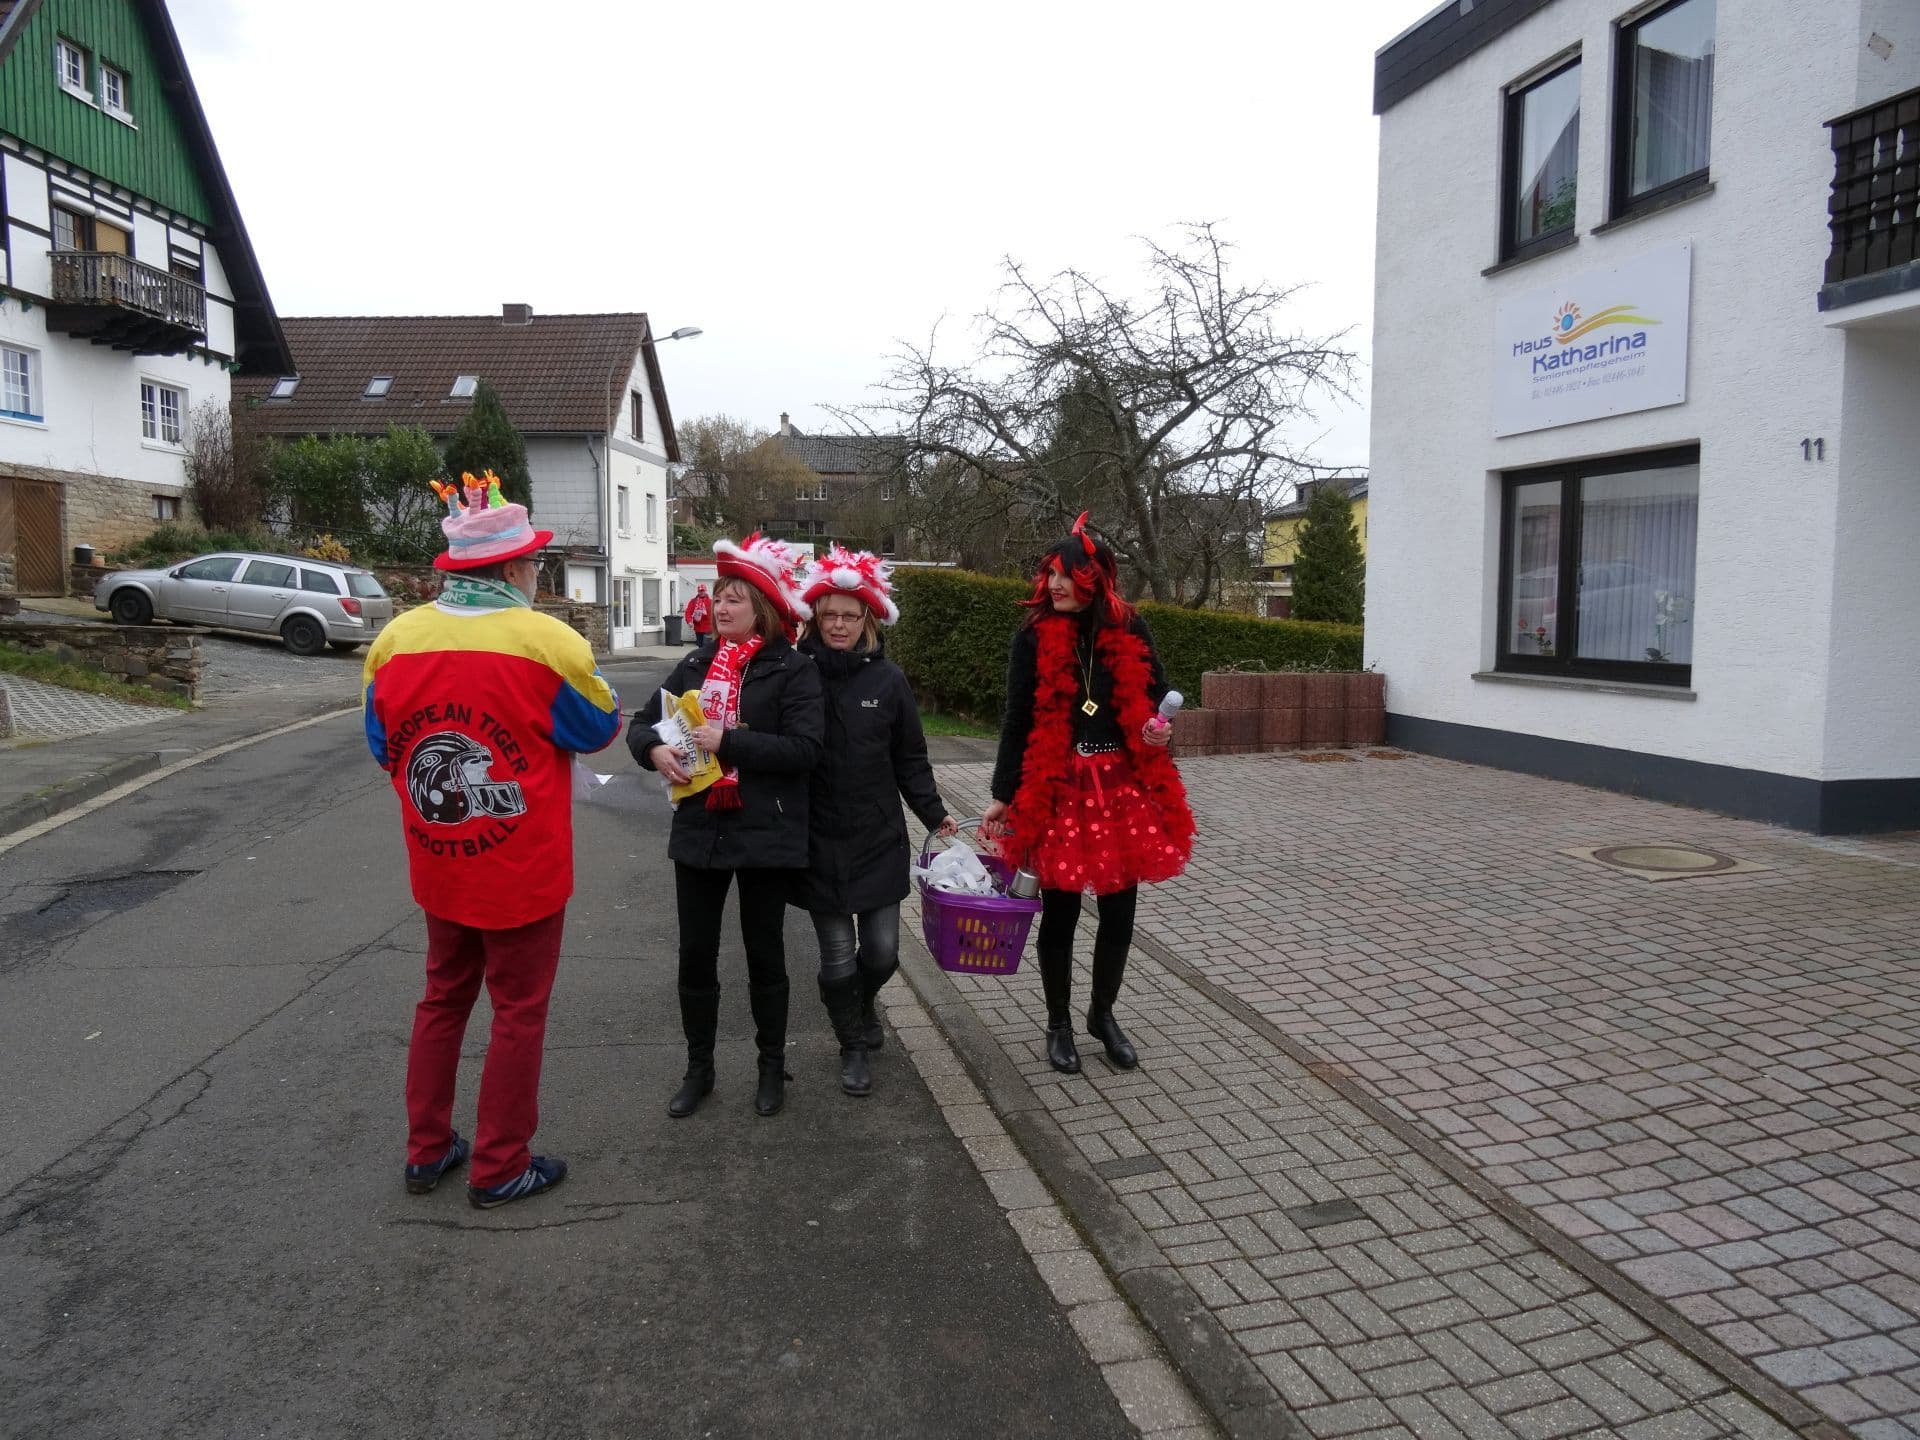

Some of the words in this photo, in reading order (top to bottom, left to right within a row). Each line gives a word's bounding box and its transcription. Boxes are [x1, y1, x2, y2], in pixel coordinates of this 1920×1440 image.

[1512, 335, 1553, 357] Haus
[1531, 331, 1647, 375] Katharina
[1531, 350, 1646, 384] Seniorenpflegeheim
[1800, 437, 1825, 461] 11
[479, 712, 529, 775] TIGER
[409, 821, 519, 858] FOOTBALL
